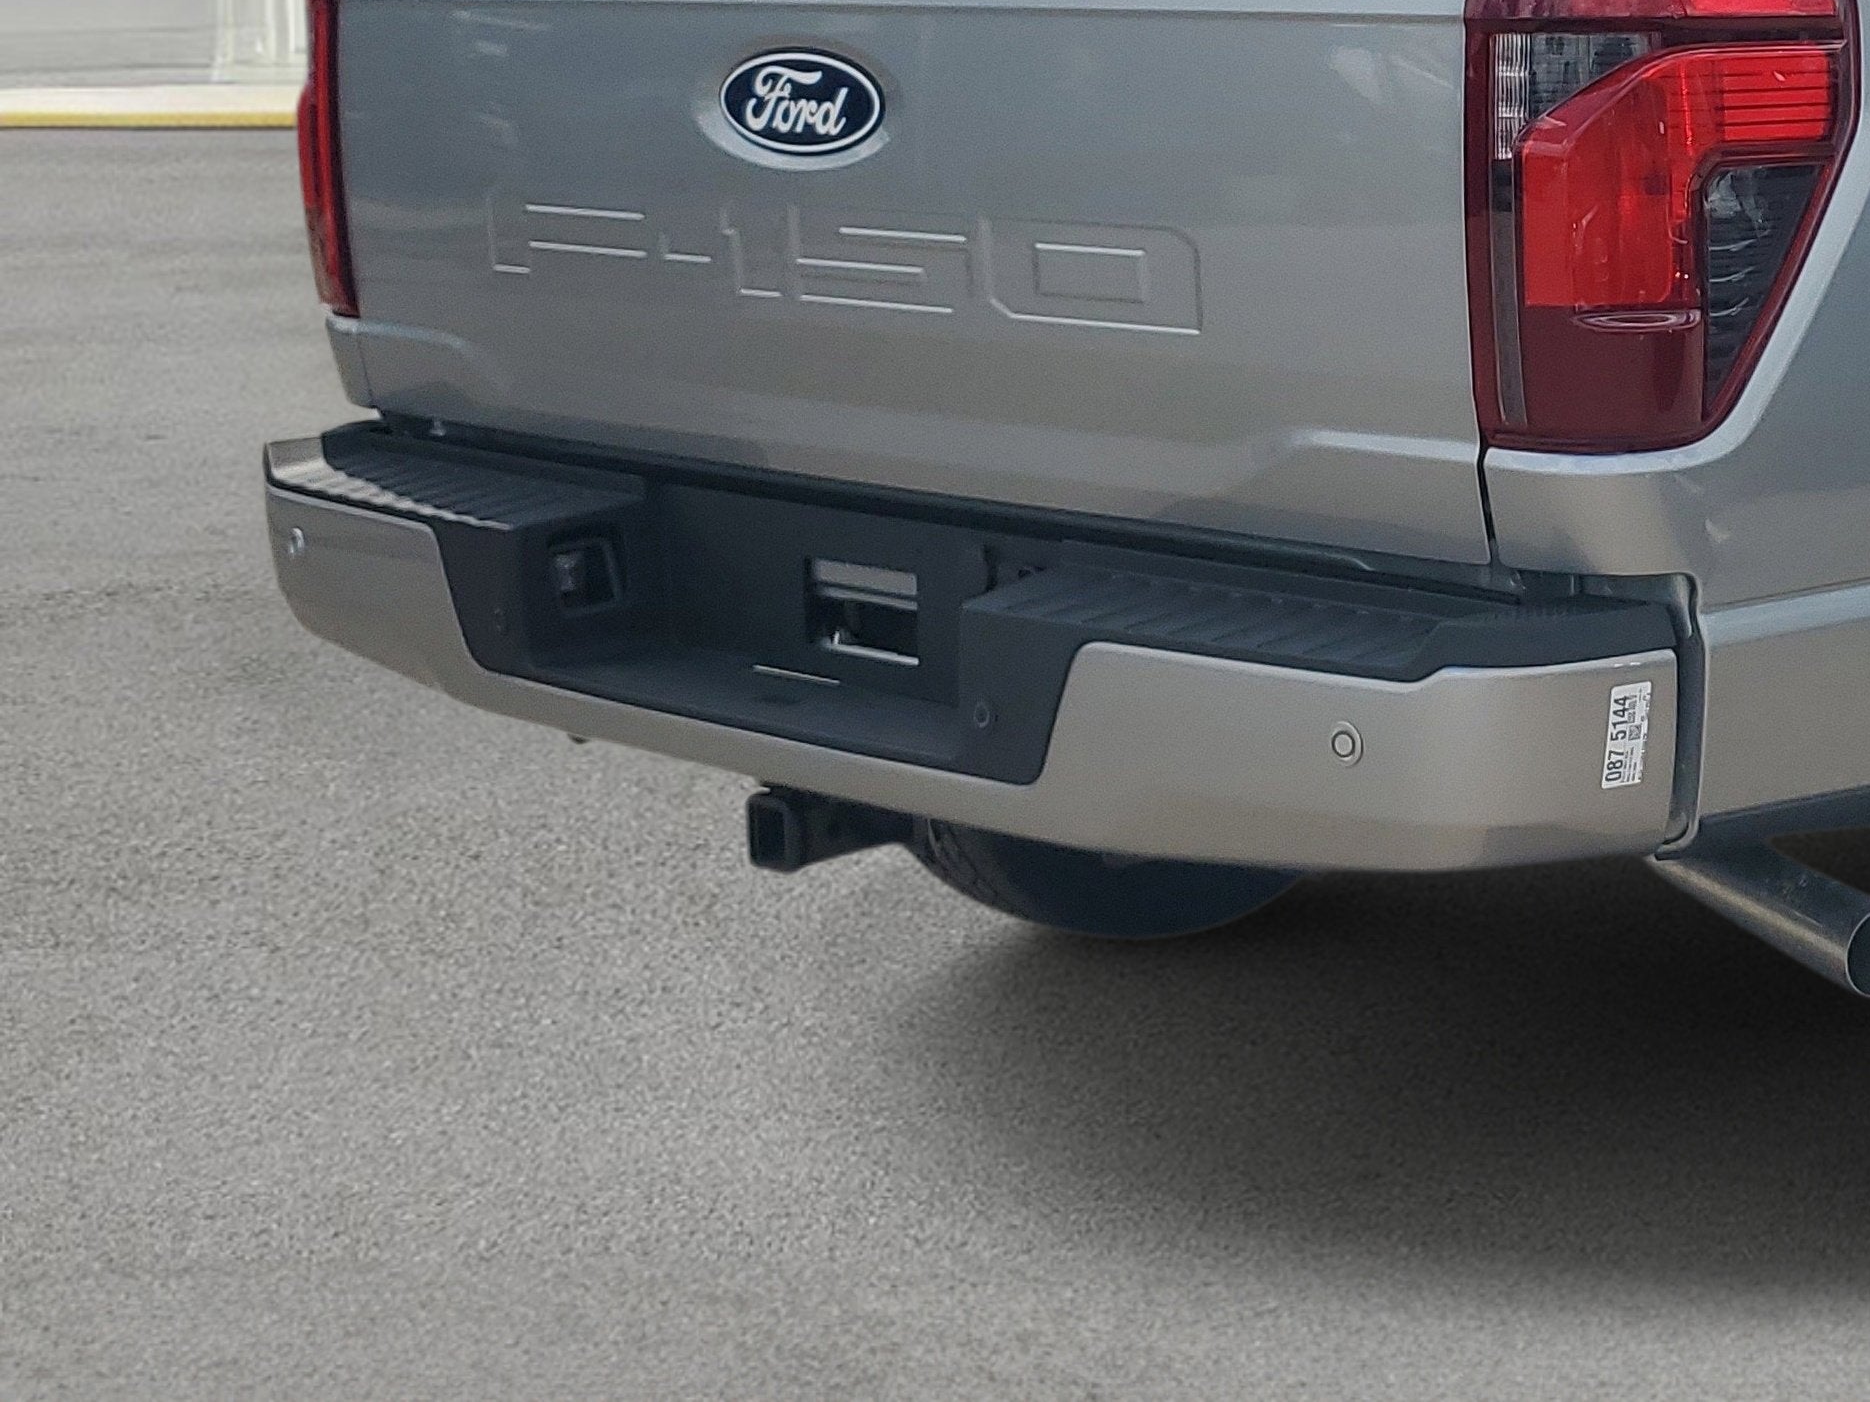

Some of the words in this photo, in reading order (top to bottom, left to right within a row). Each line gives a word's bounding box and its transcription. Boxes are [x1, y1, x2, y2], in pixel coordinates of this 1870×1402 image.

[746, 65, 848, 136] Ford
[488, 195, 1204, 336] F-150
[1610, 695, 1630, 742] 5144
[1605, 750, 1625, 782] 087
